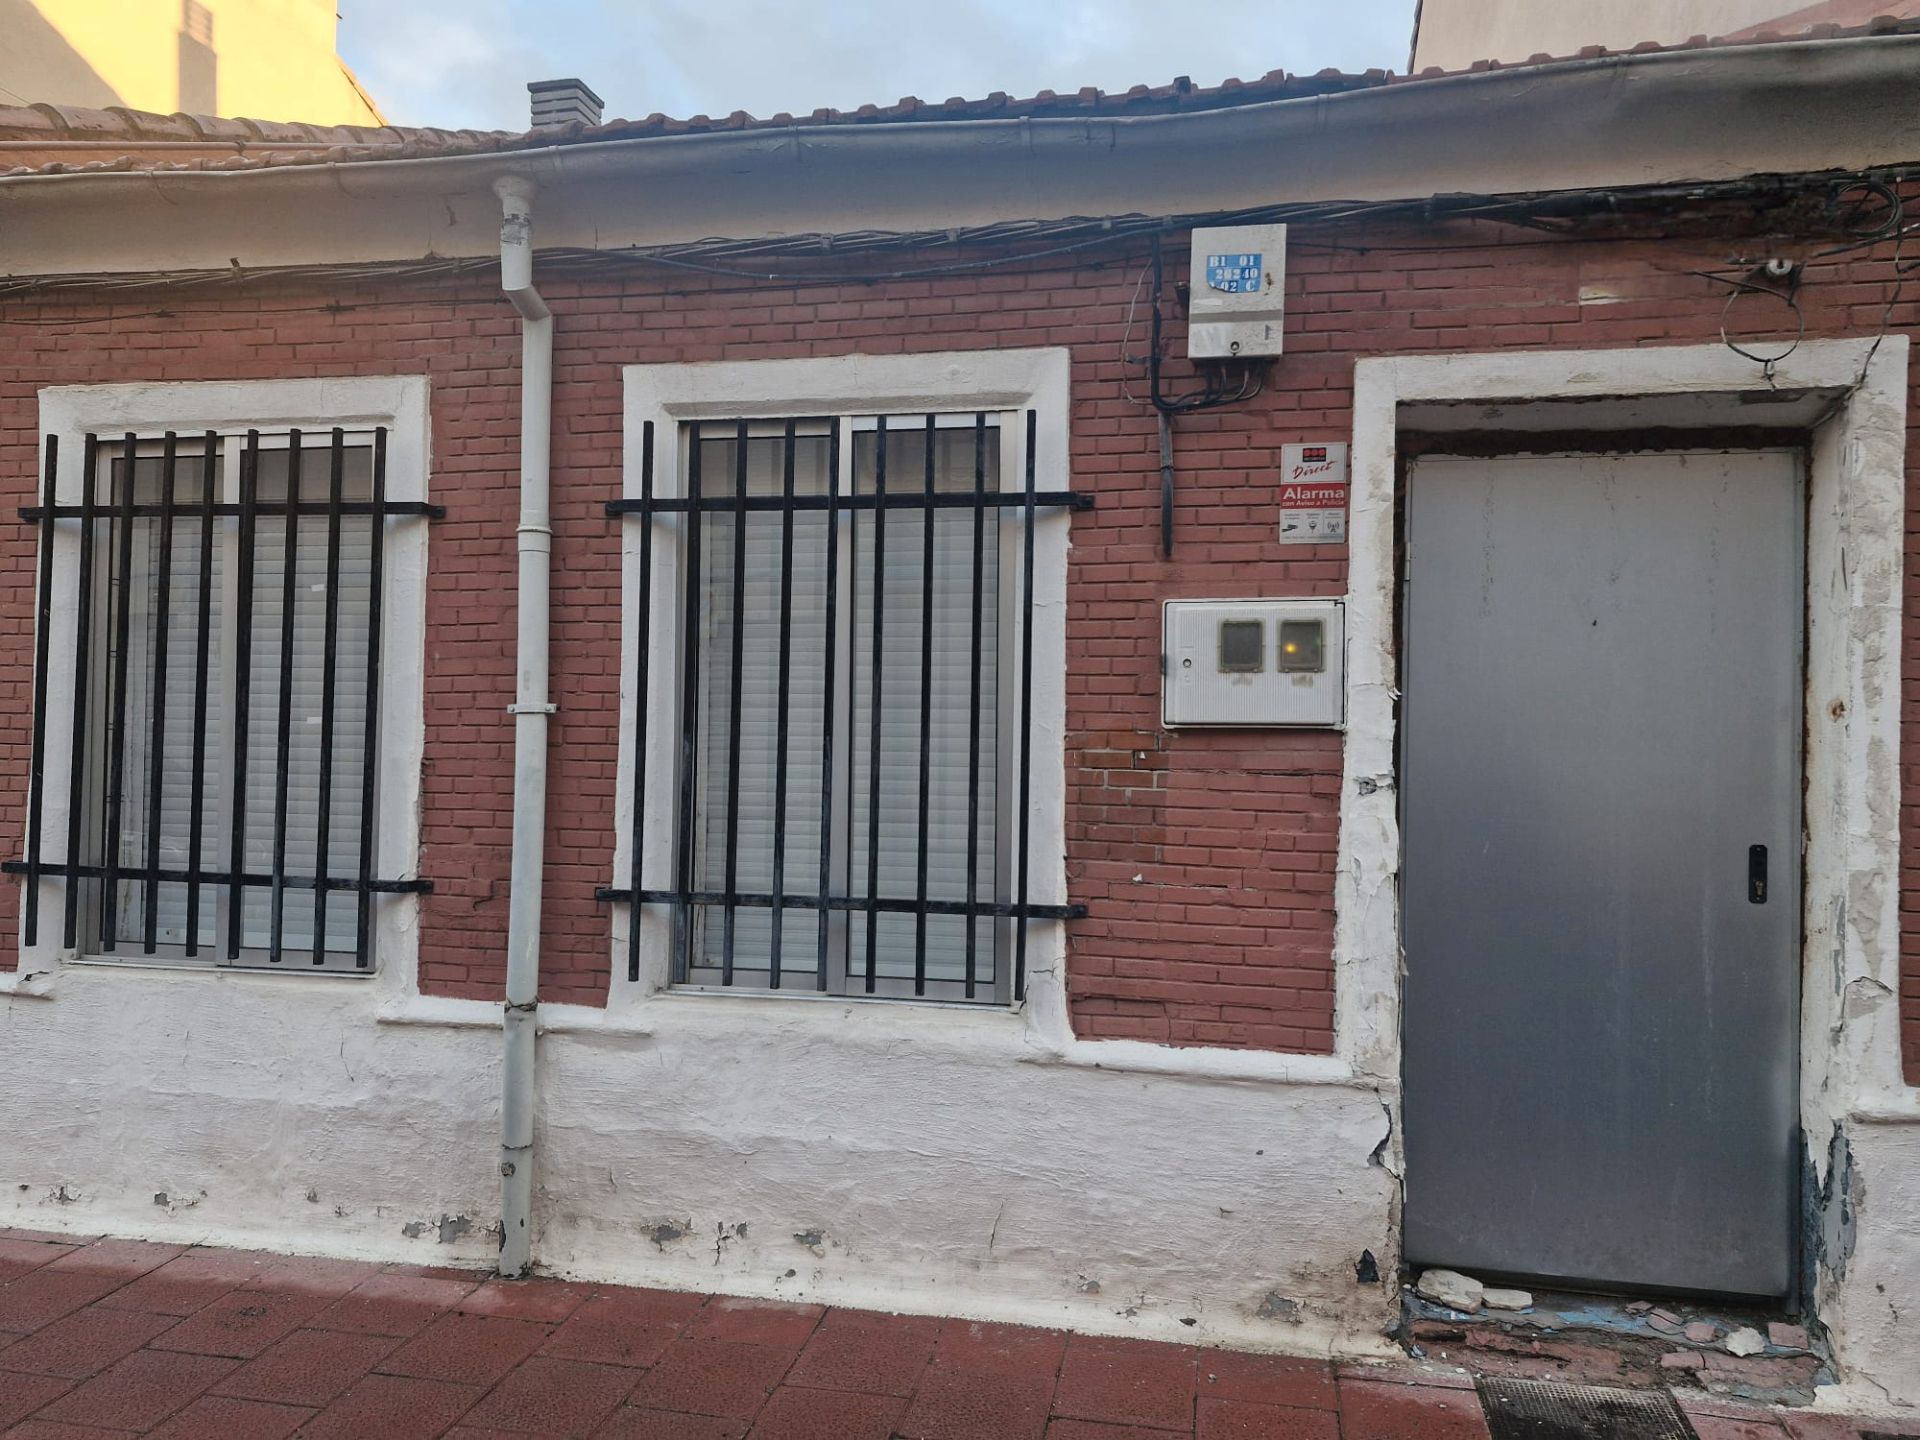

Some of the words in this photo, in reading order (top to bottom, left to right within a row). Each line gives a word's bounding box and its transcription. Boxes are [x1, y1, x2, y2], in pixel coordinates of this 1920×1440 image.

[1210, 256, 1226, 267] B1
[1292, 460, 1338, 480] Direct
[1283, 487, 1344, 500] Alarma
